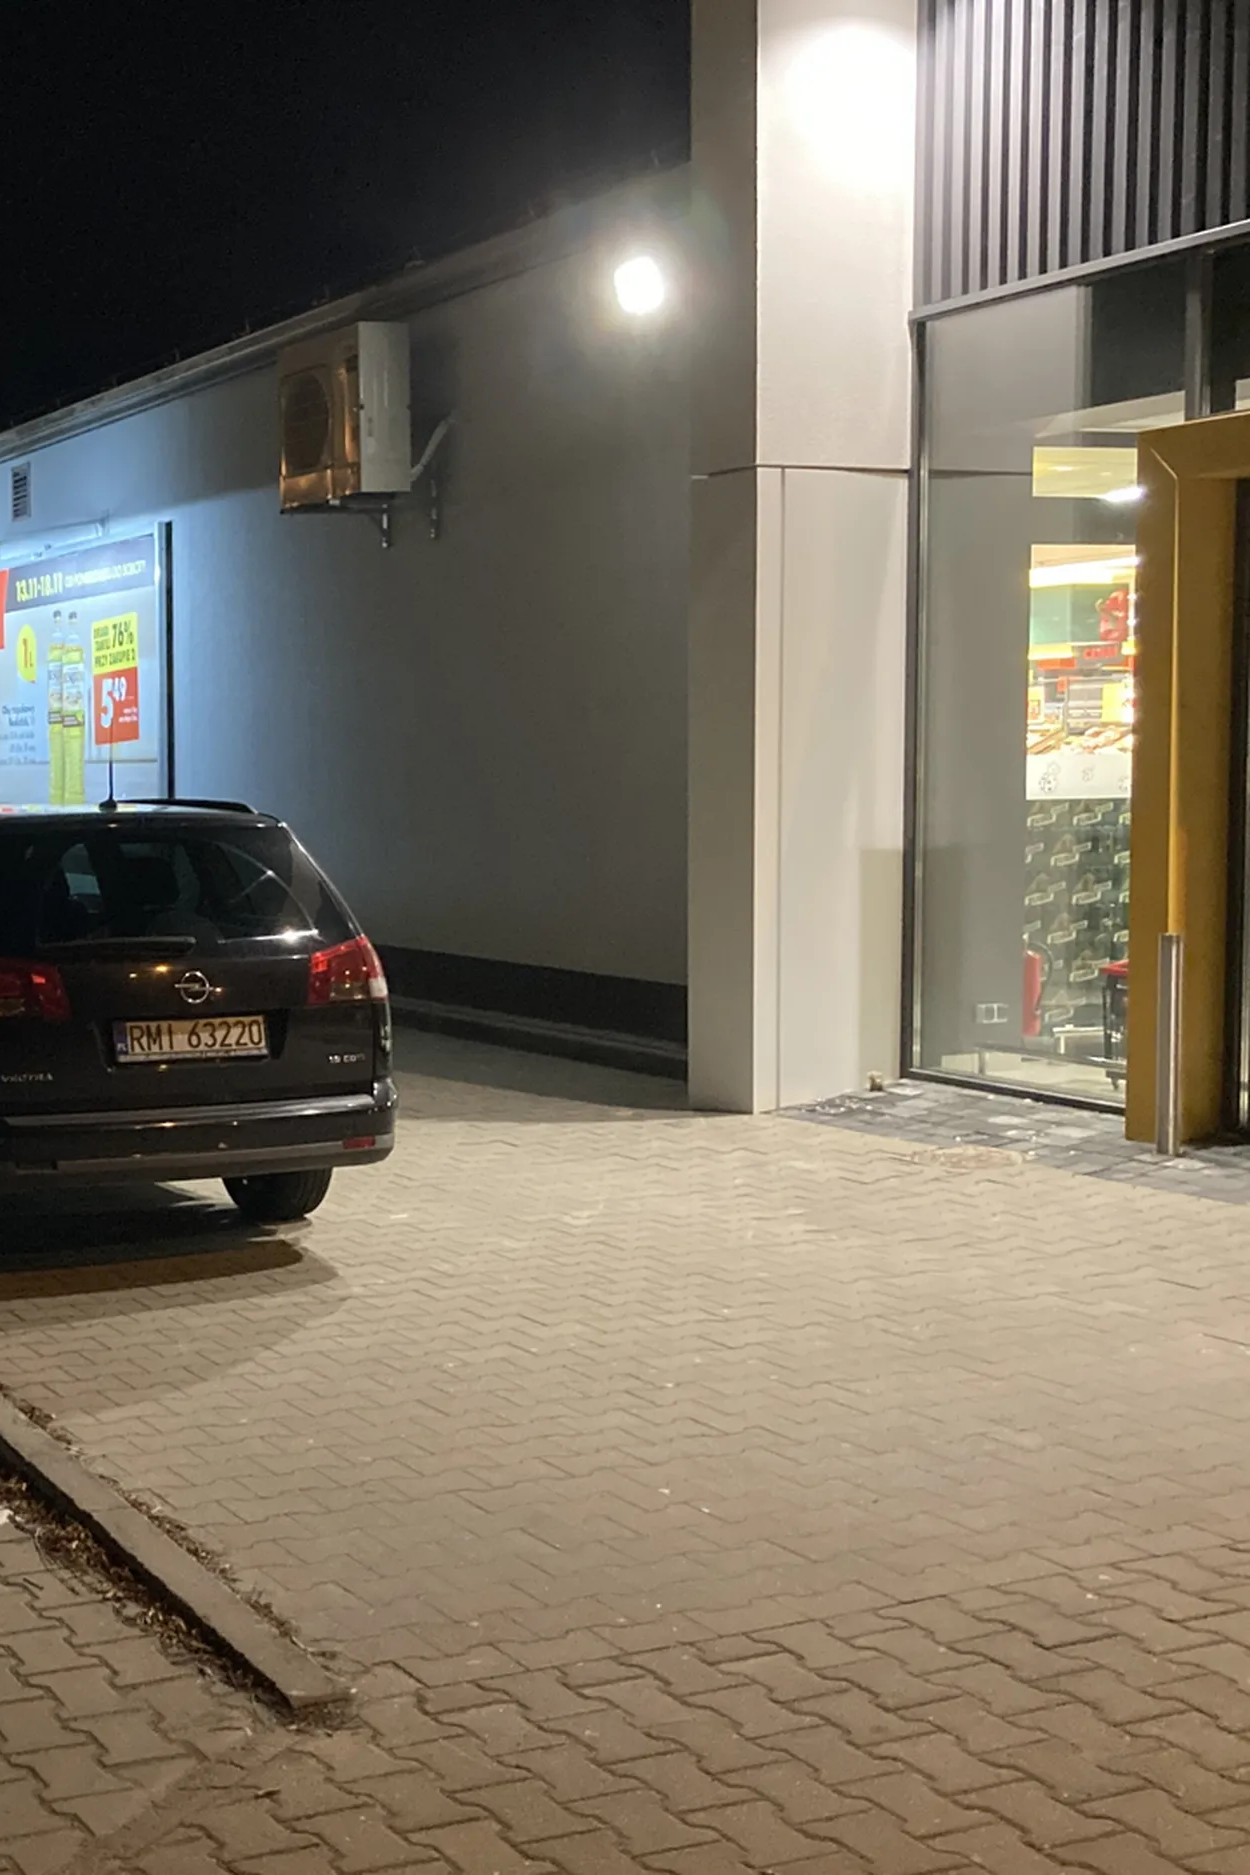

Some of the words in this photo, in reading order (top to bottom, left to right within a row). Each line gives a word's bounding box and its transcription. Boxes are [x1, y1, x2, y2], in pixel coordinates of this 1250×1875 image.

[112, 619, 135, 648] 76%
[128, 1023, 174, 1053] RMI
[187, 1019, 263, 1049] 63220
